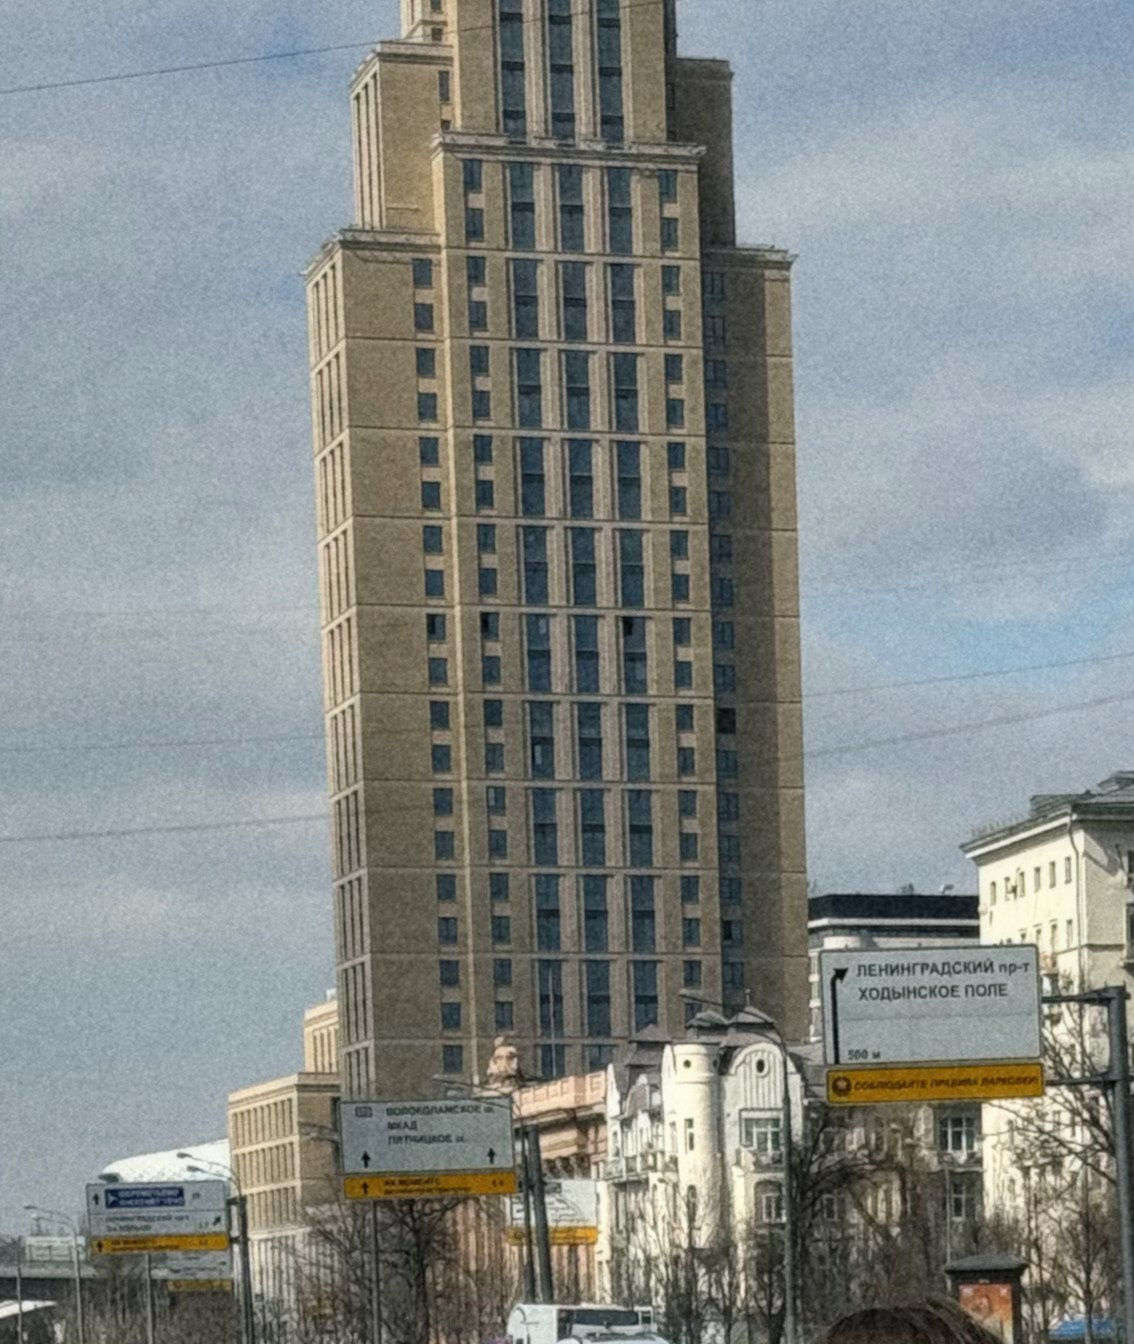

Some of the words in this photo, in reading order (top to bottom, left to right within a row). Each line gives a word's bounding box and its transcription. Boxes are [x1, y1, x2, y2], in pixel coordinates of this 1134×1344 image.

[856, 958, 995, 977] ЛЕНИНГРАДСКИЙ
[998, 961, 1030, 976] пр-т
[858, 984, 961, 1001] ХОДЫНСКОЕ
[964, 983, 1009, 998] ПОЛЕ
